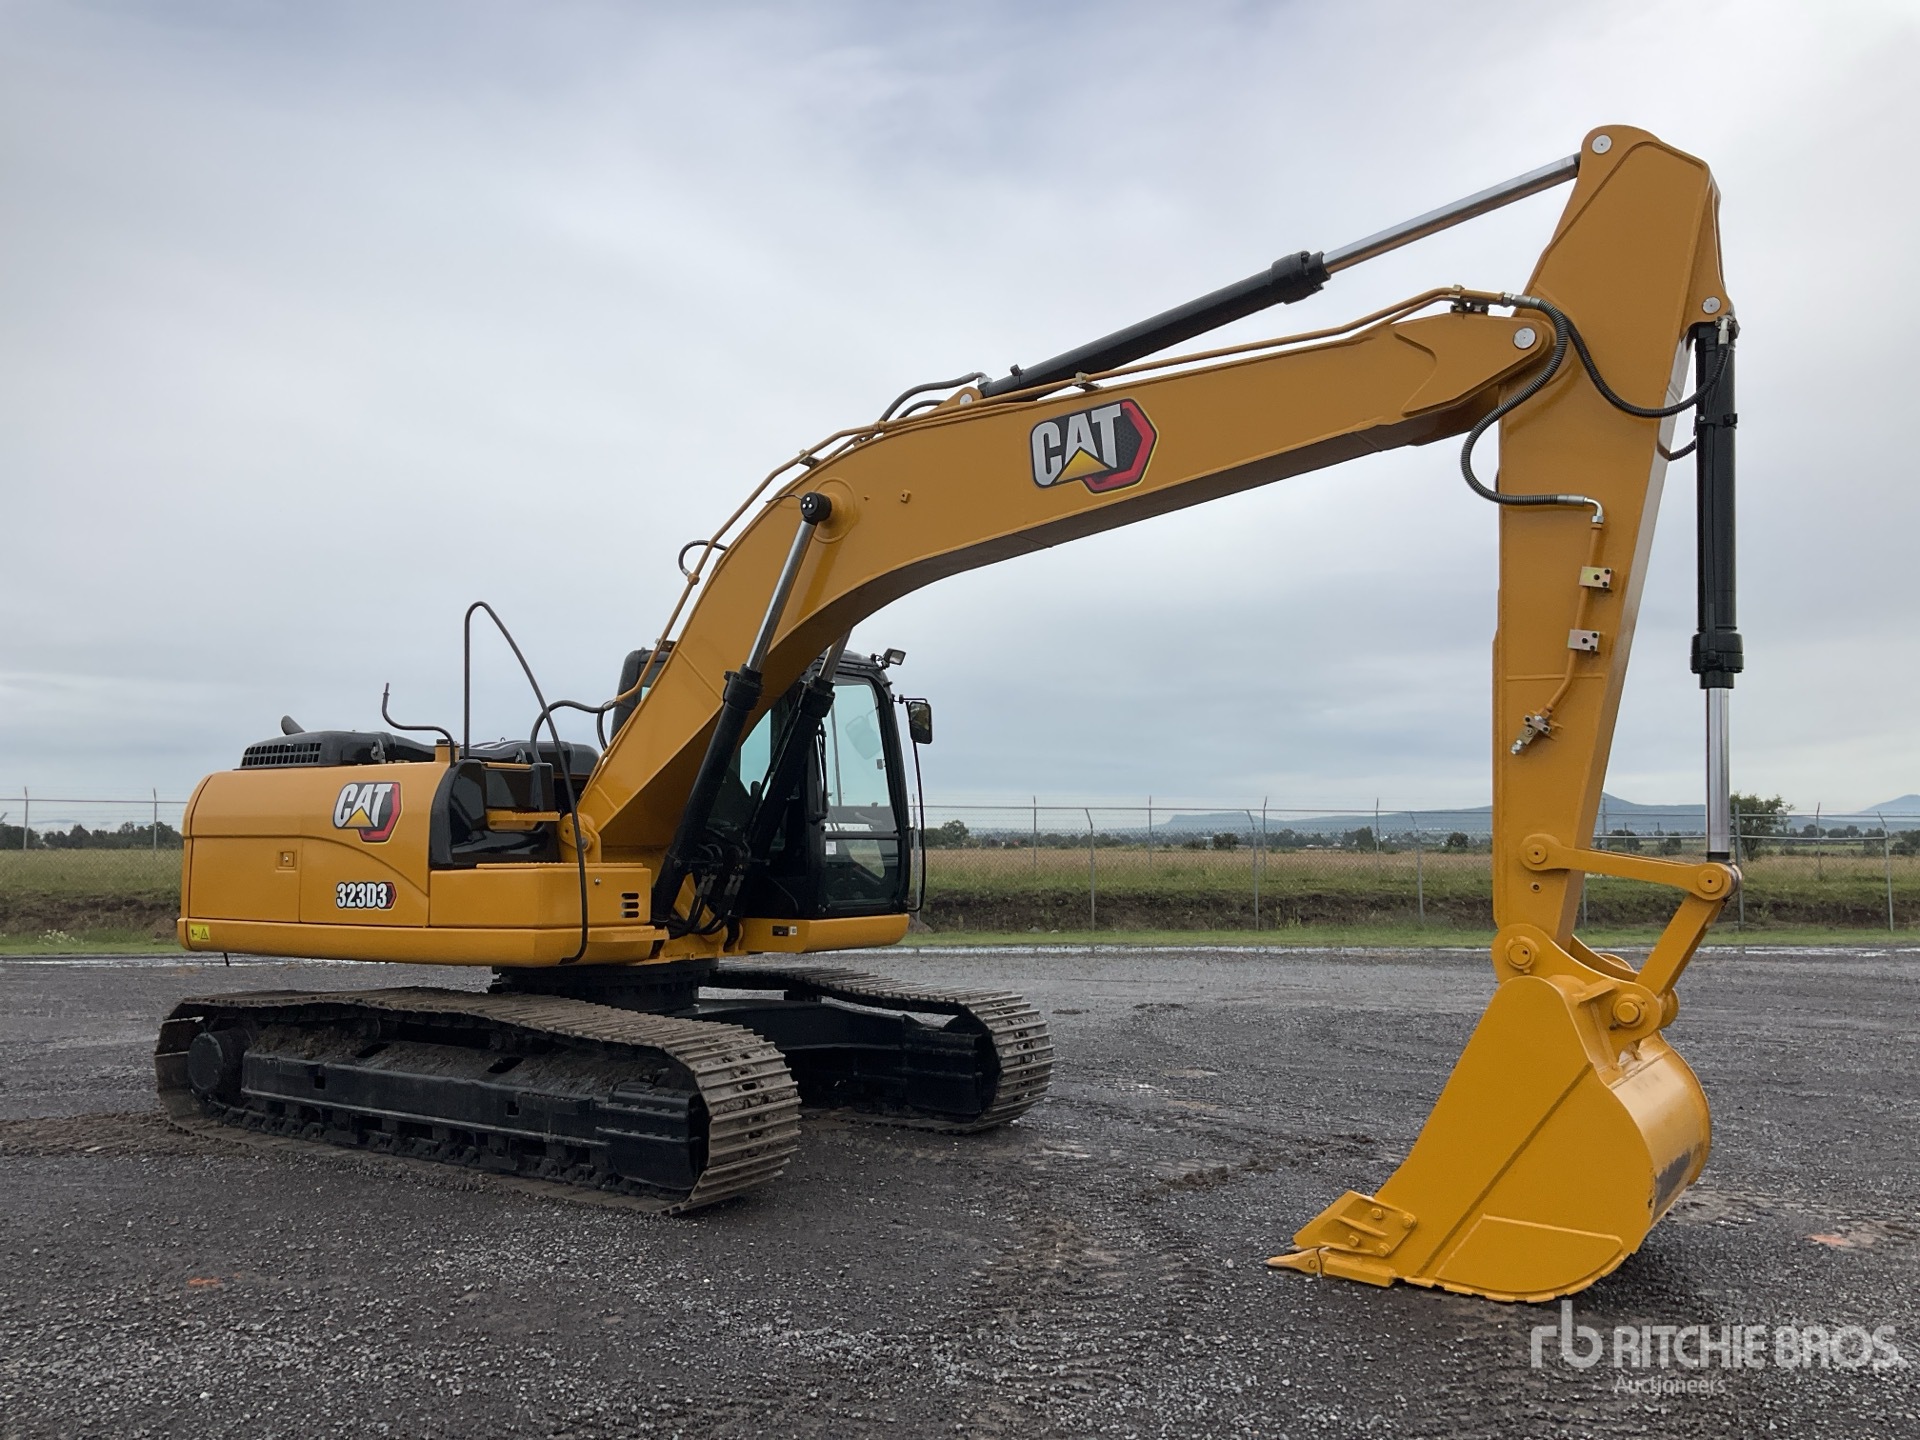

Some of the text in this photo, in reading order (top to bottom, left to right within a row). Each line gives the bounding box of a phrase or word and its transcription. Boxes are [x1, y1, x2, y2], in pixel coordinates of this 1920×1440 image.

[1031, 403, 1122, 487] CAT
[333, 783, 393, 828] CAT
[336, 883, 388, 908] 323D3
